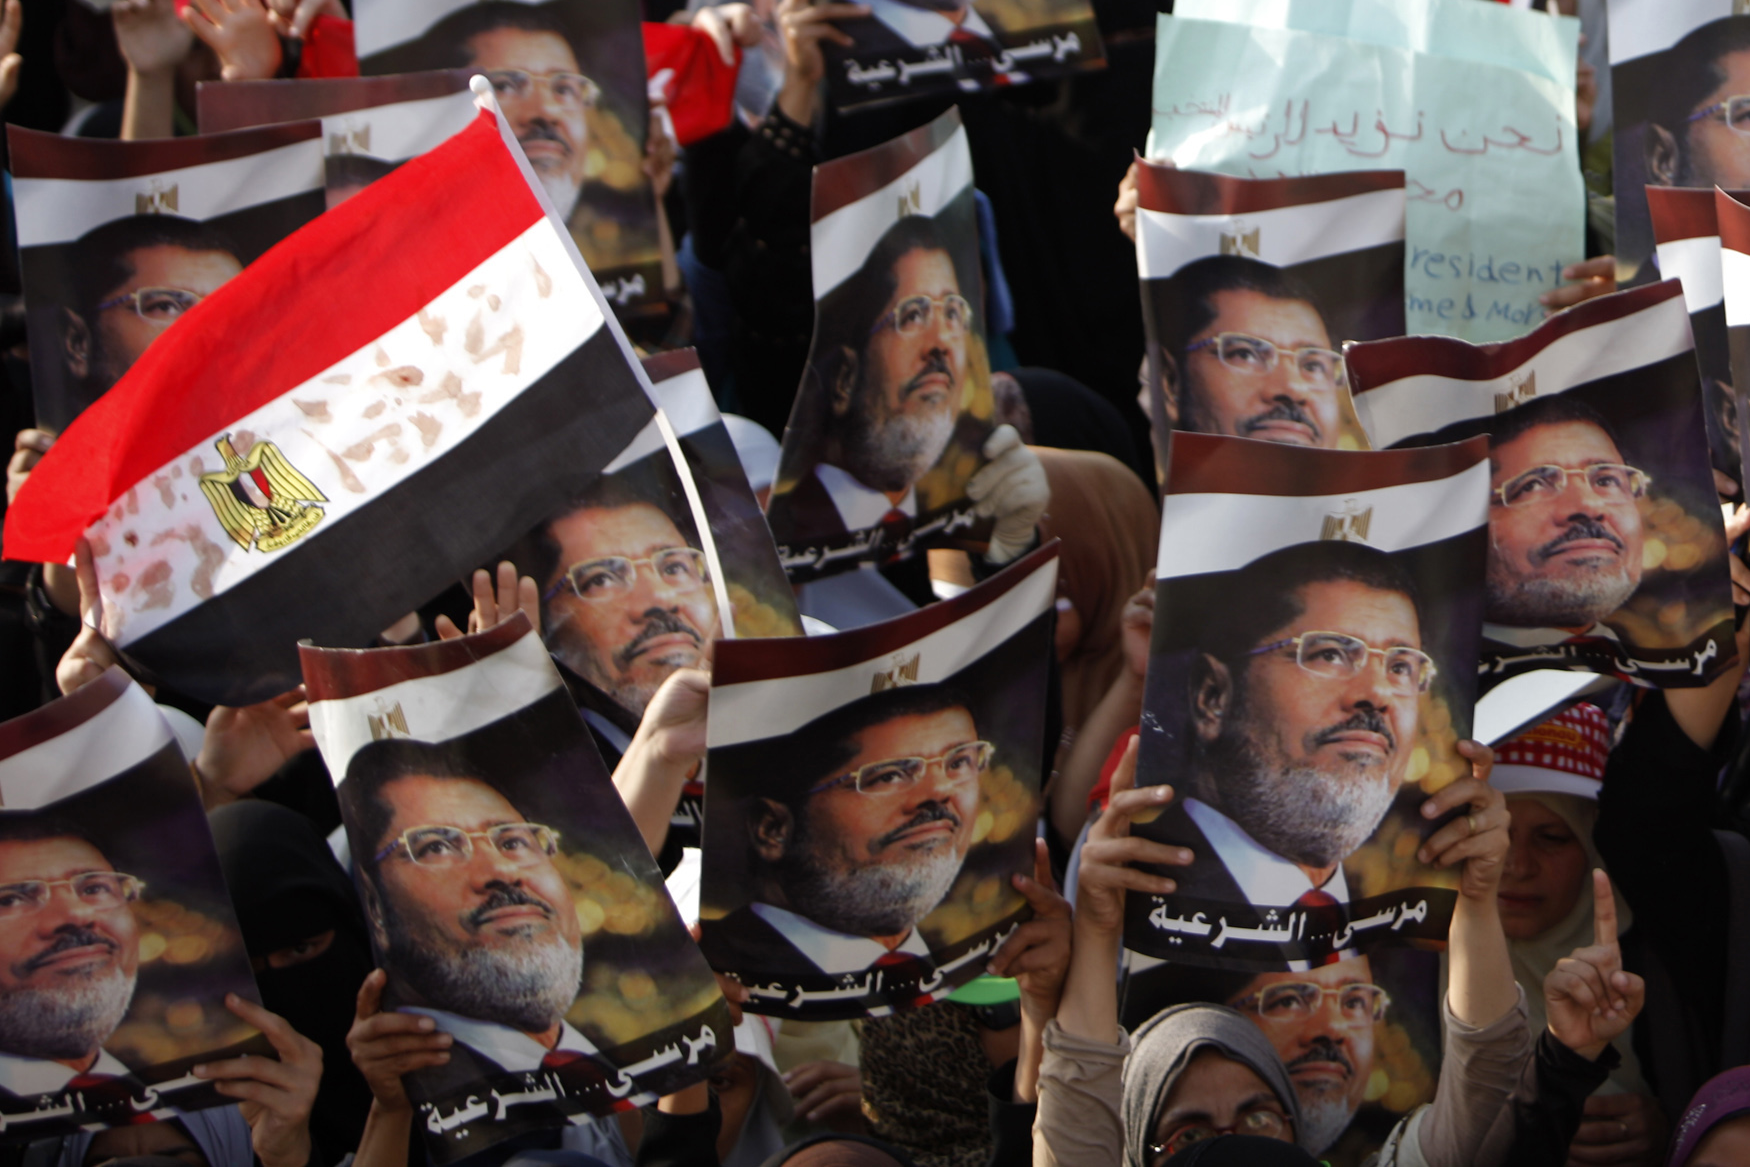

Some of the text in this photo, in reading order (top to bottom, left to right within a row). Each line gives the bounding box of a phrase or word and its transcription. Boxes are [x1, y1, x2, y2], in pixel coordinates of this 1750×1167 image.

[847, 42, 961, 88] الشرعية
[1440, 115, 1563, 156] نحن
[1411, 245, 1566, 287] resident
[1148, 895, 1305, 949] الشرعية
[420, 1072, 565, 1139] الشرعية
